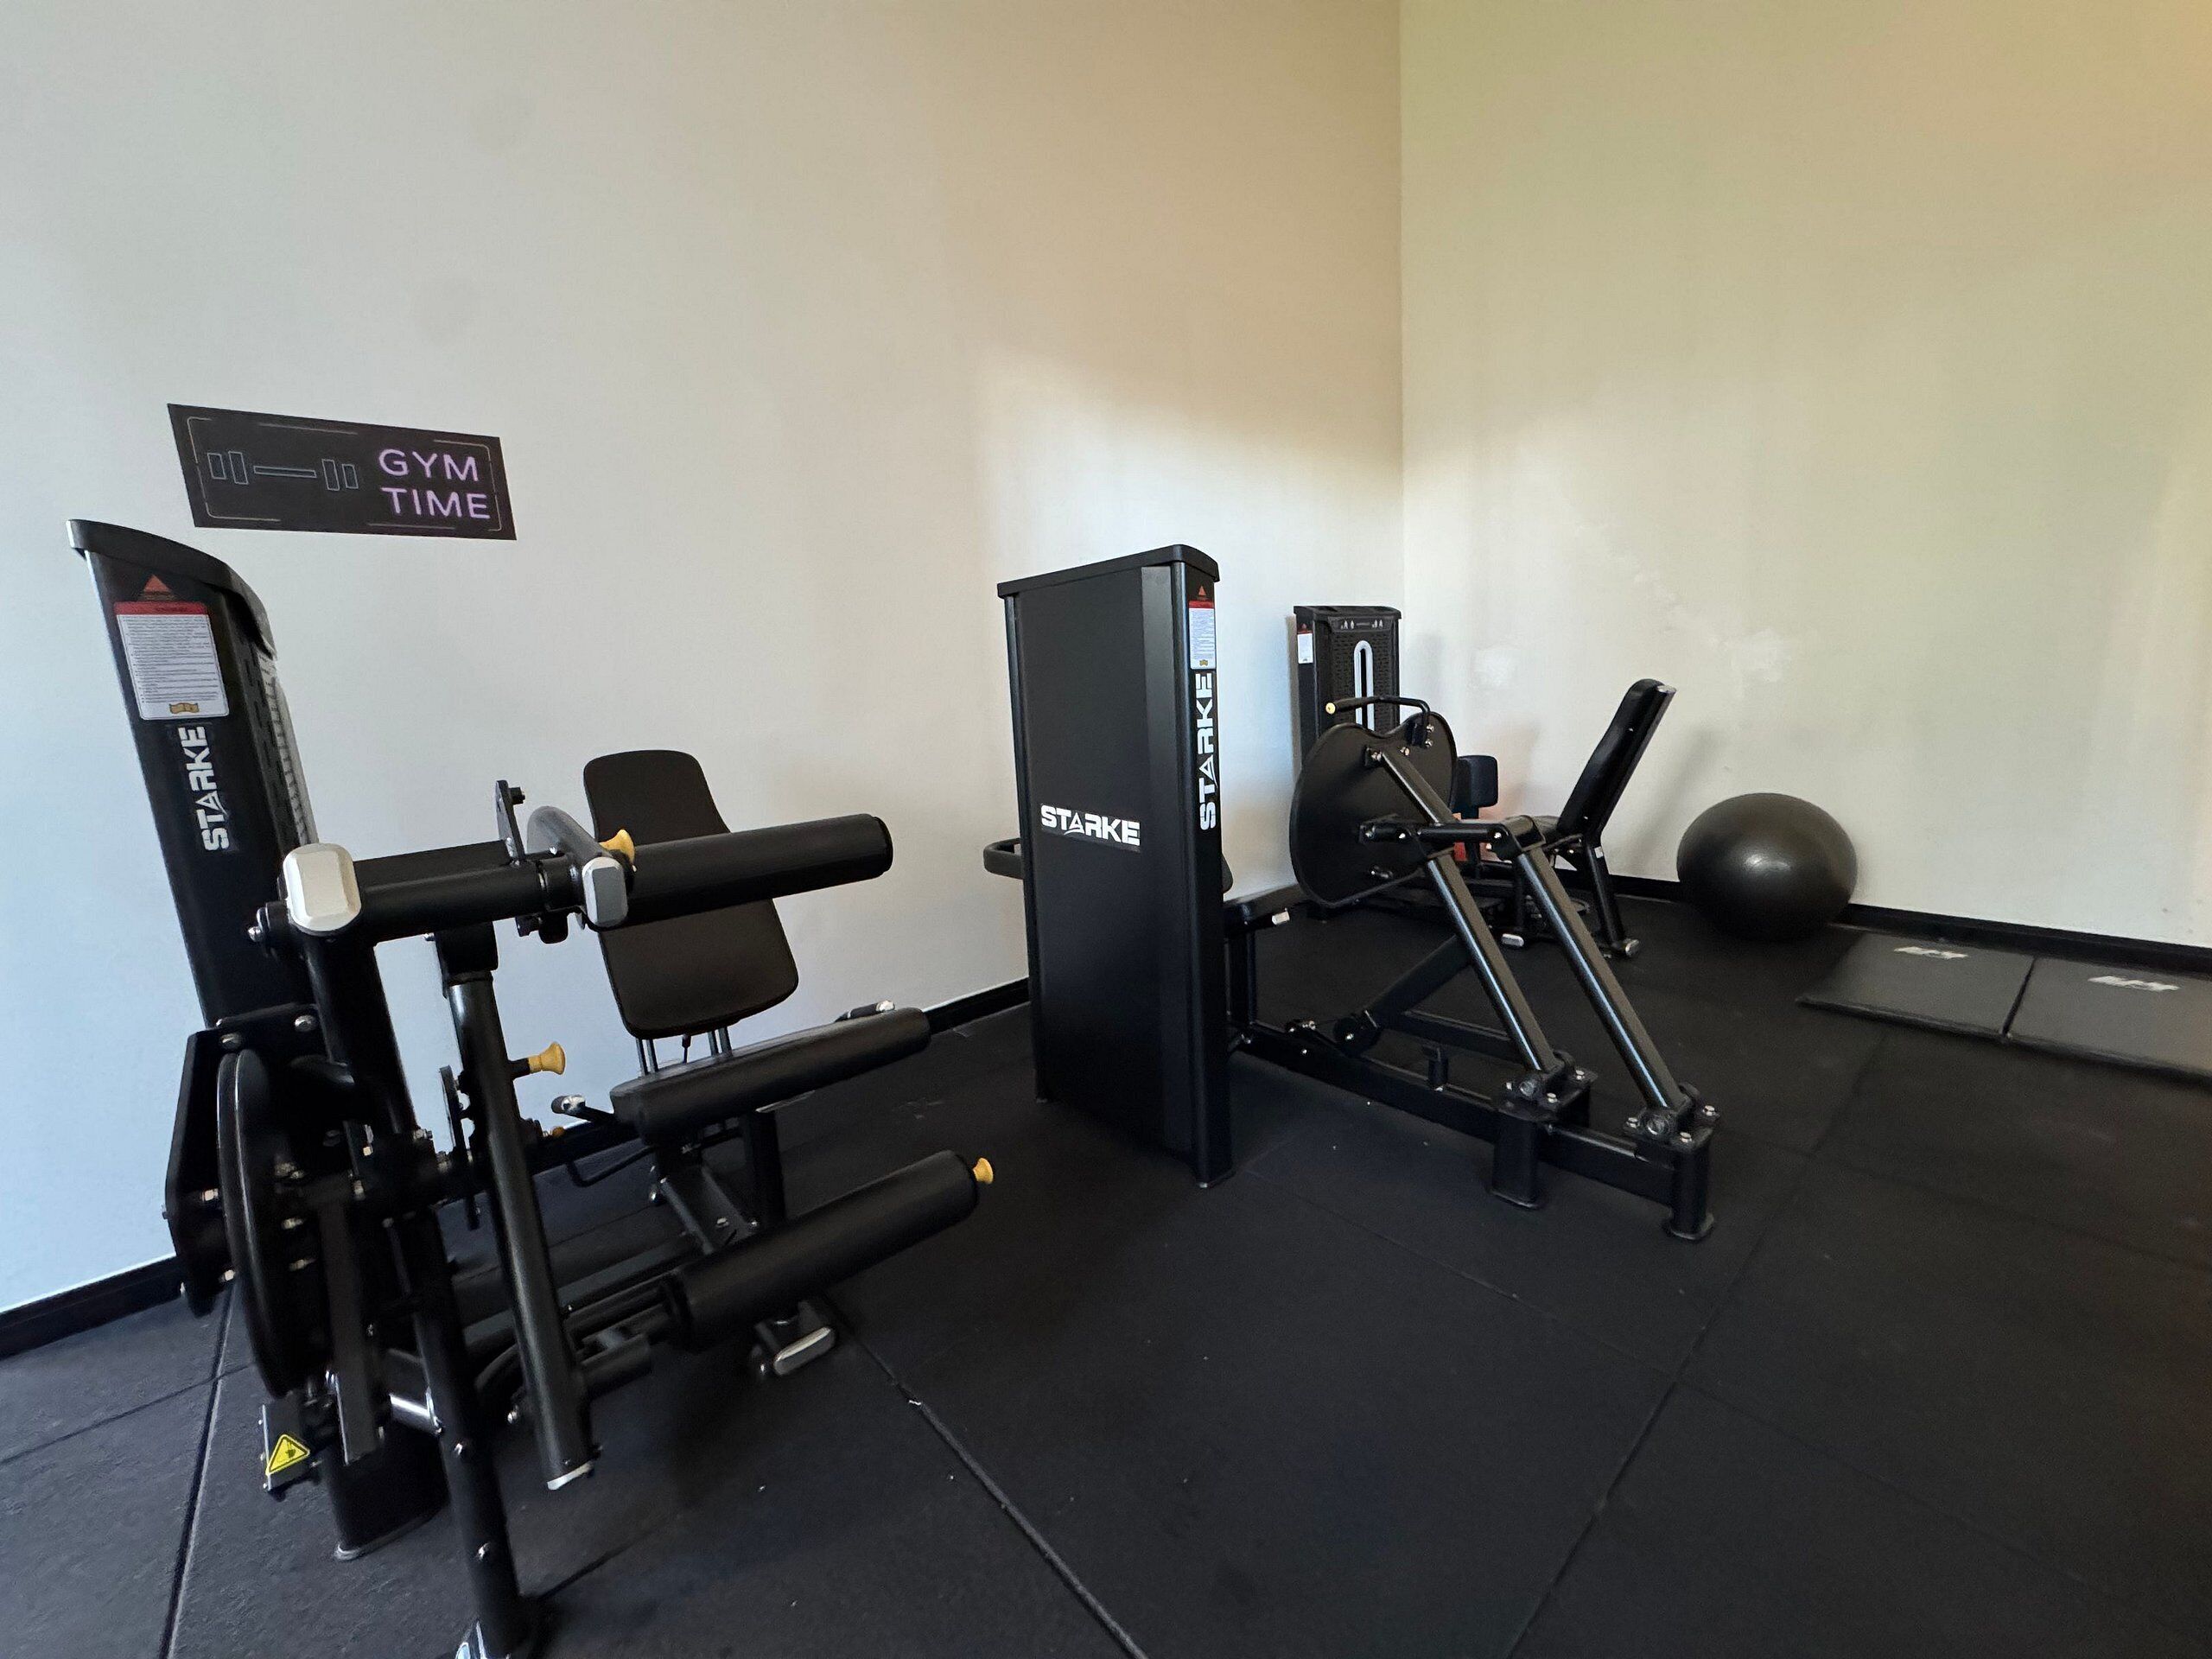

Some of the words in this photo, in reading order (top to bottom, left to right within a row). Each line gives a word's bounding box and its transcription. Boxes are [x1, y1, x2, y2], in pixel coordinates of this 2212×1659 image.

[378, 448, 479, 482] GYM
[380, 486, 492, 520] TIME
[1194, 671, 1217, 831] STARKE
[177, 726, 231, 852] STARKE
[1040, 804, 1141, 847] STARKE
